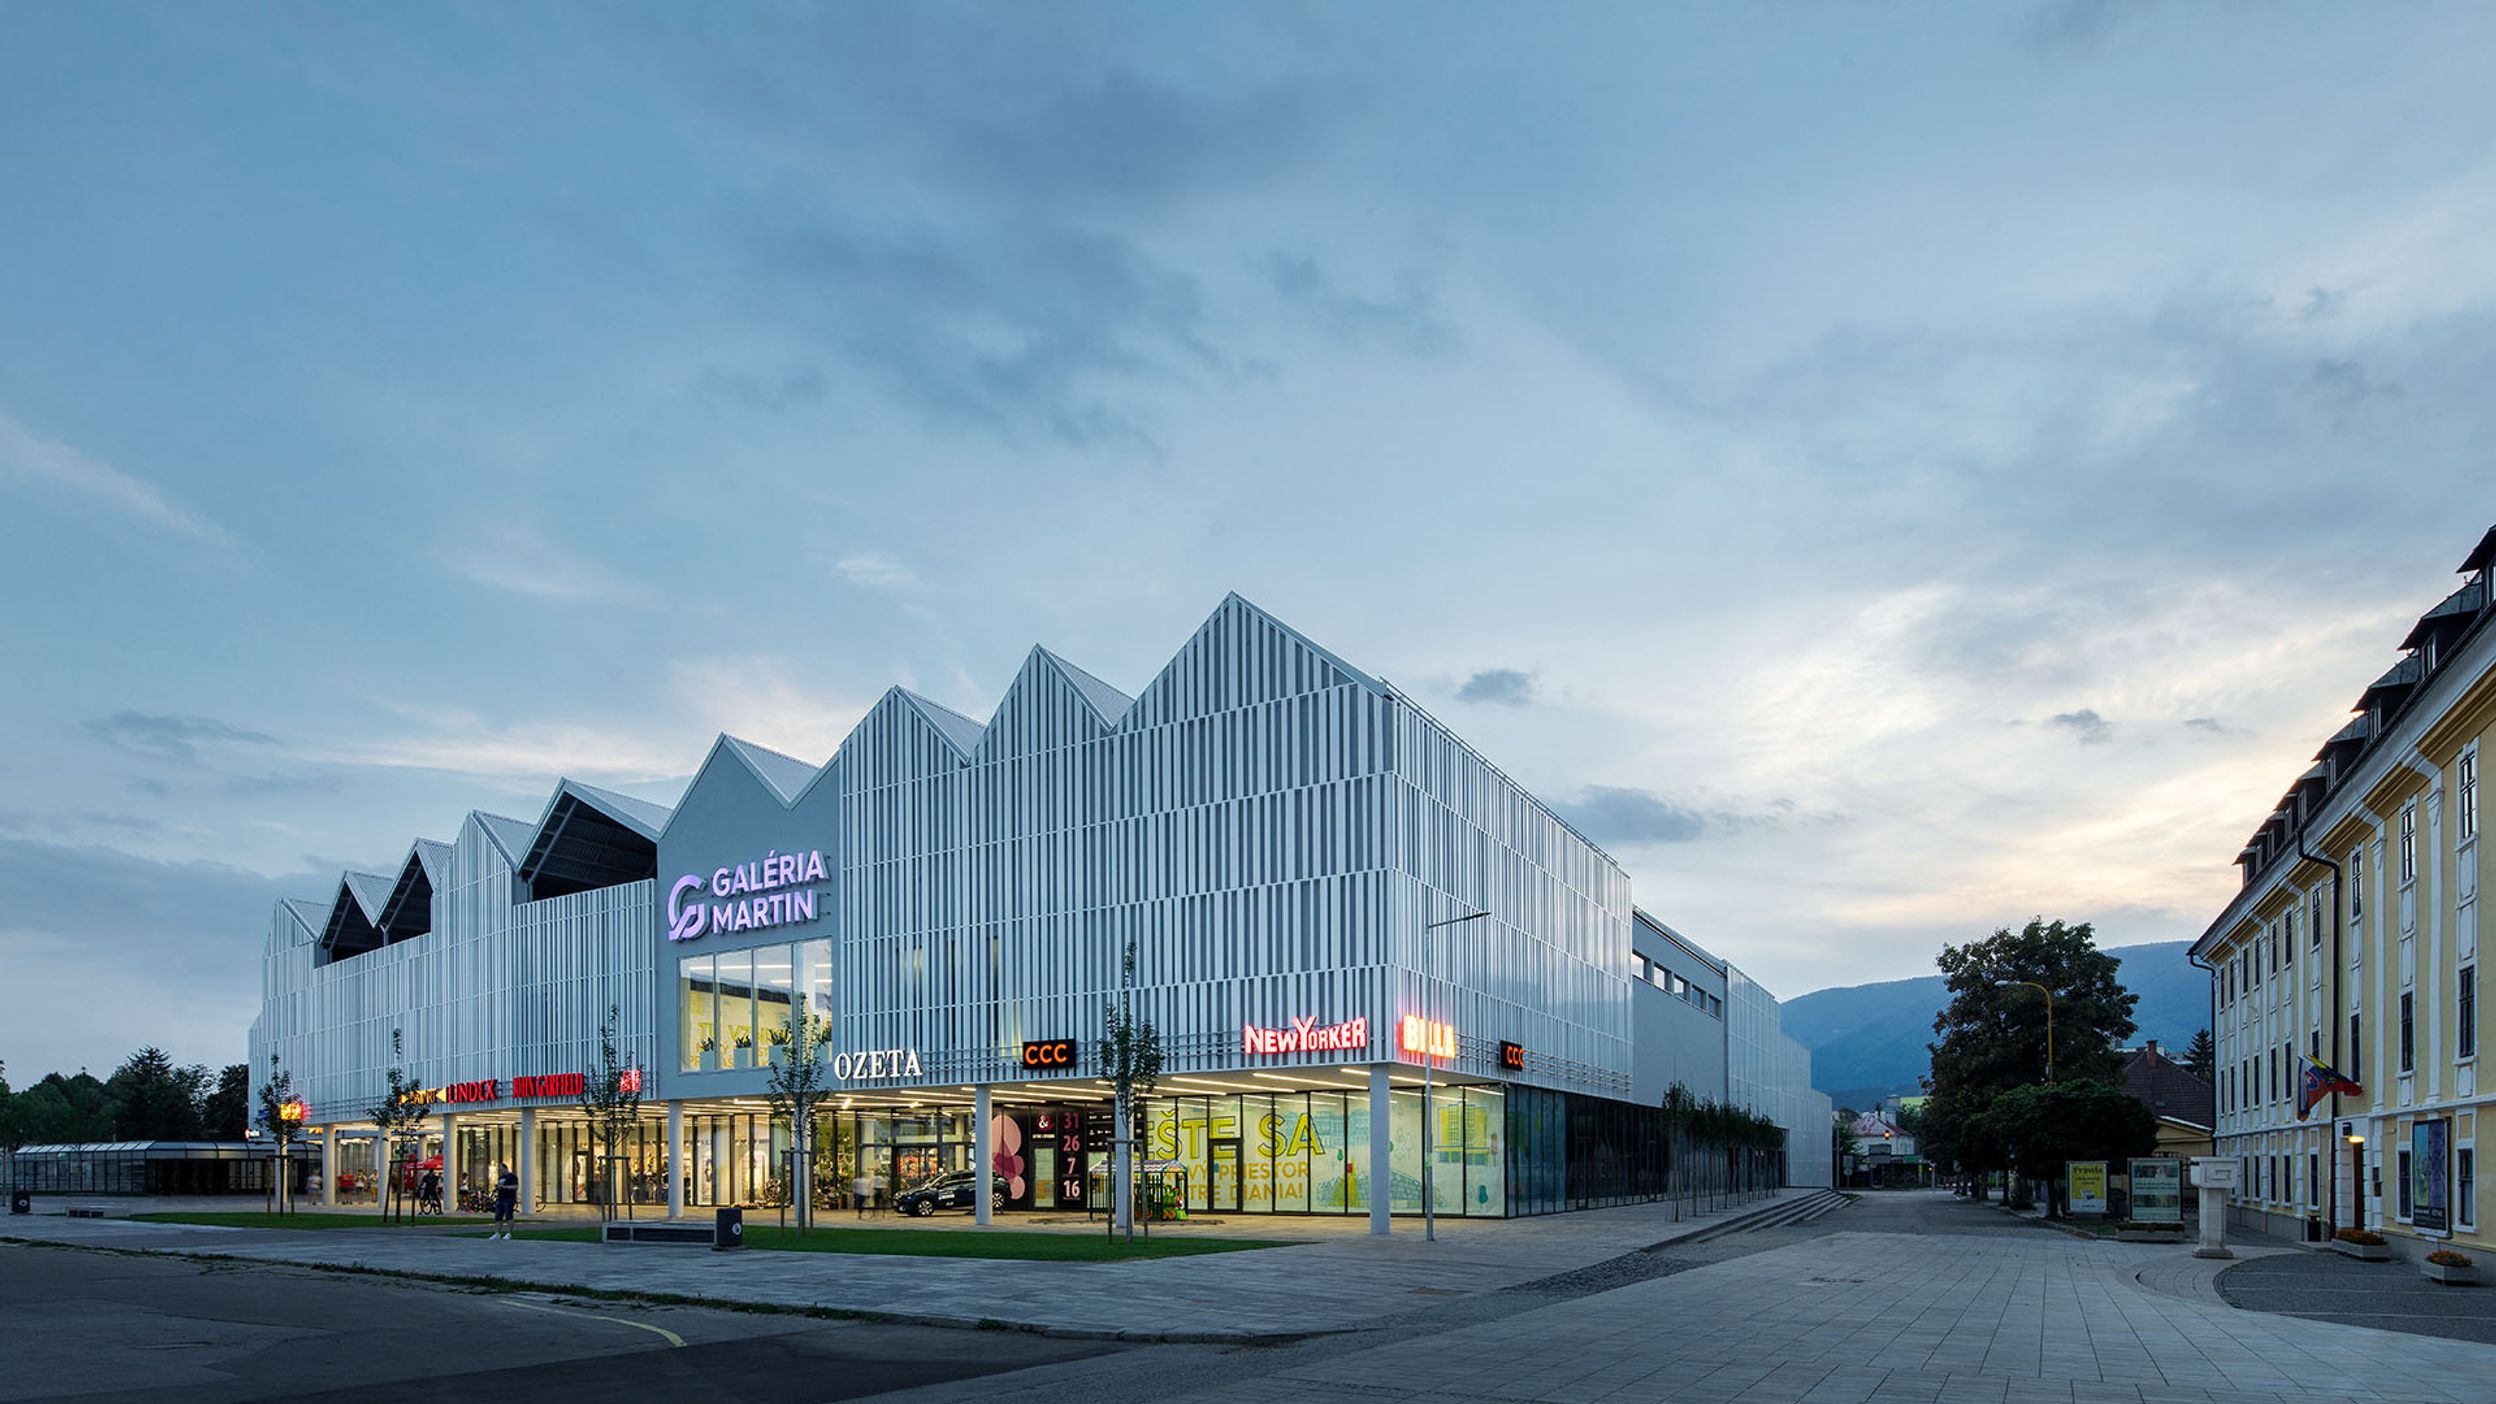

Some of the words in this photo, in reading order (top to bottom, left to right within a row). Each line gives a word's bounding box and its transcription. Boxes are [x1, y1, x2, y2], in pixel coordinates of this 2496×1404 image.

[712, 850, 827, 897] GALÉRIA
[712, 889, 815, 934] MARTIN
[1402, 1015, 1456, 1059] BILLA
[834, 1048, 923, 1080] OZETA
[1025, 1043, 1067, 1065] CCC
[1506, 1045, 1524, 1067] CCC
[447, 1079, 497, 1104] LINDEX
[512, 1076, 535, 1098] JOHN
[536, 1072, 584, 1097] GARFIELD
[1064, 1112, 1080, 1130] 31
[1063, 1135, 1080, 1152] 26
[1257, 1112, 1325, 1159] SA
[1067, 1157, 1076, 1174] 7
[1063, 1180, 1080, 1197] 16
